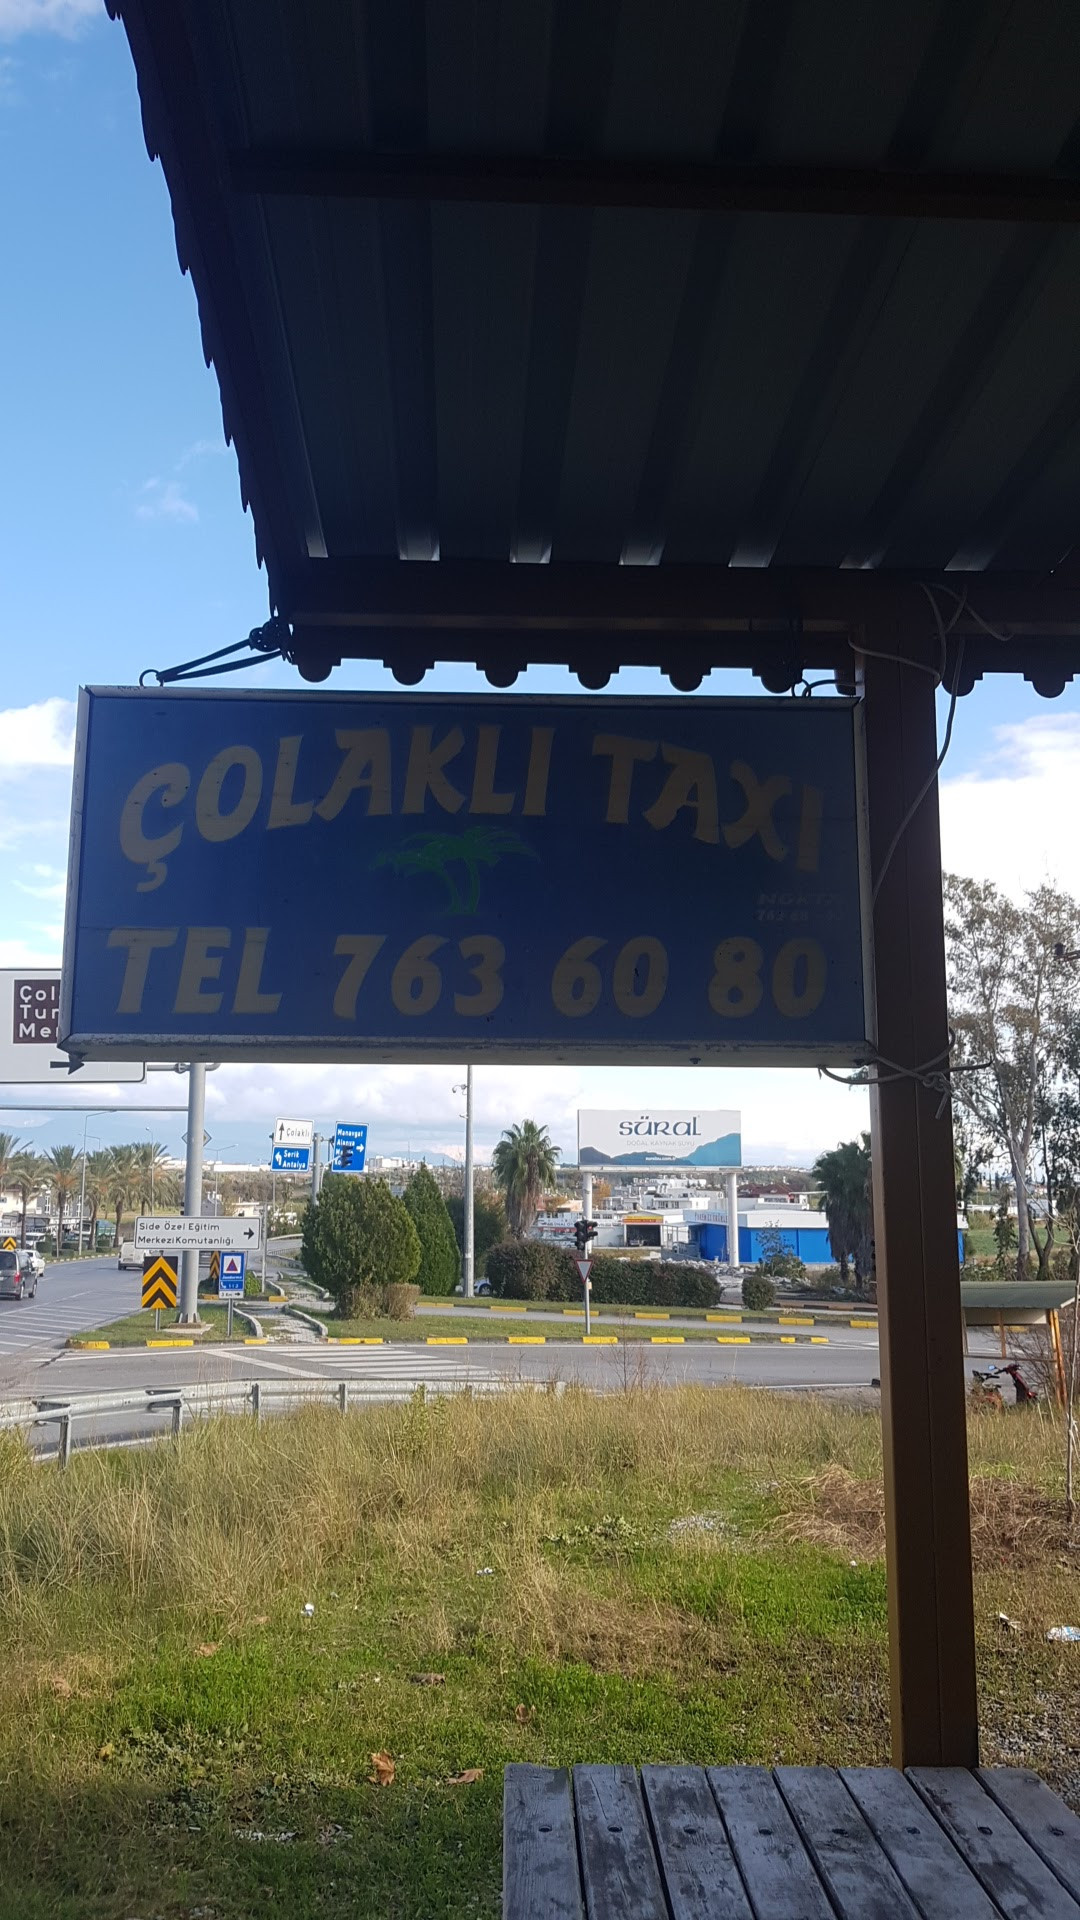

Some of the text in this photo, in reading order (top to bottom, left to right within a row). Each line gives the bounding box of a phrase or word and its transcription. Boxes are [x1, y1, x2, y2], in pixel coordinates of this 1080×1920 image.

[119, 725, 825, 893] ÇOLAKLI TAXI
[106, 926, 827, 1020] TEL 763 60 80
[20, 985, 60, 1003] Çol
[19, 1022, 58, 1038] Me
[337, 1128, 364, 1139] Manavgat
[283, 1149, 300, 1158] Serik
[282, 1160, 306, 1170] Antalya
[139, 1220, 220, 1233] Side Özel Eğitim
[138, 1236, 234, 1246] Merkezi Komutanlığı
